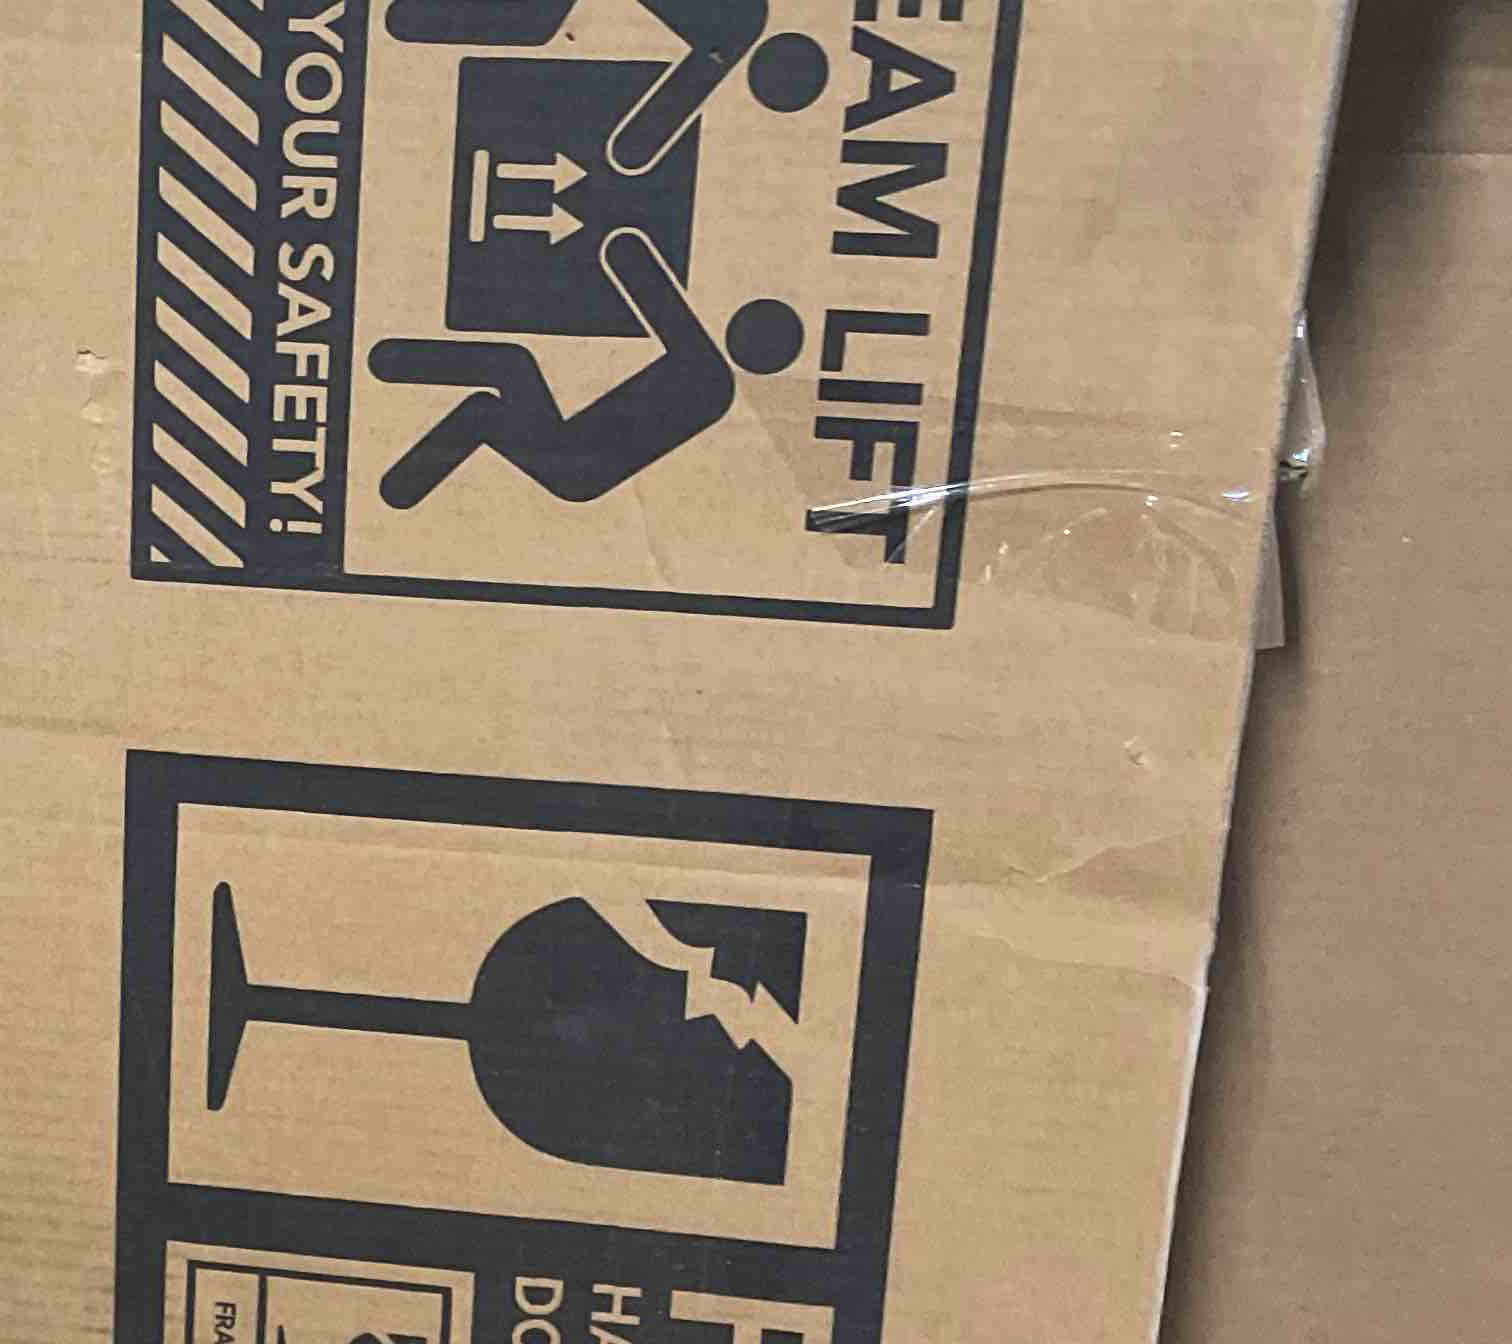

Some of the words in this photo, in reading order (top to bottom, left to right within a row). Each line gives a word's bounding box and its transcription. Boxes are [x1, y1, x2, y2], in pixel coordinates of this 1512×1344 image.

[280, 0, 347, 219] YOUR
[269, 241, 335, 534] SAFETY!
[805, 308, 931, 565] LIFT
